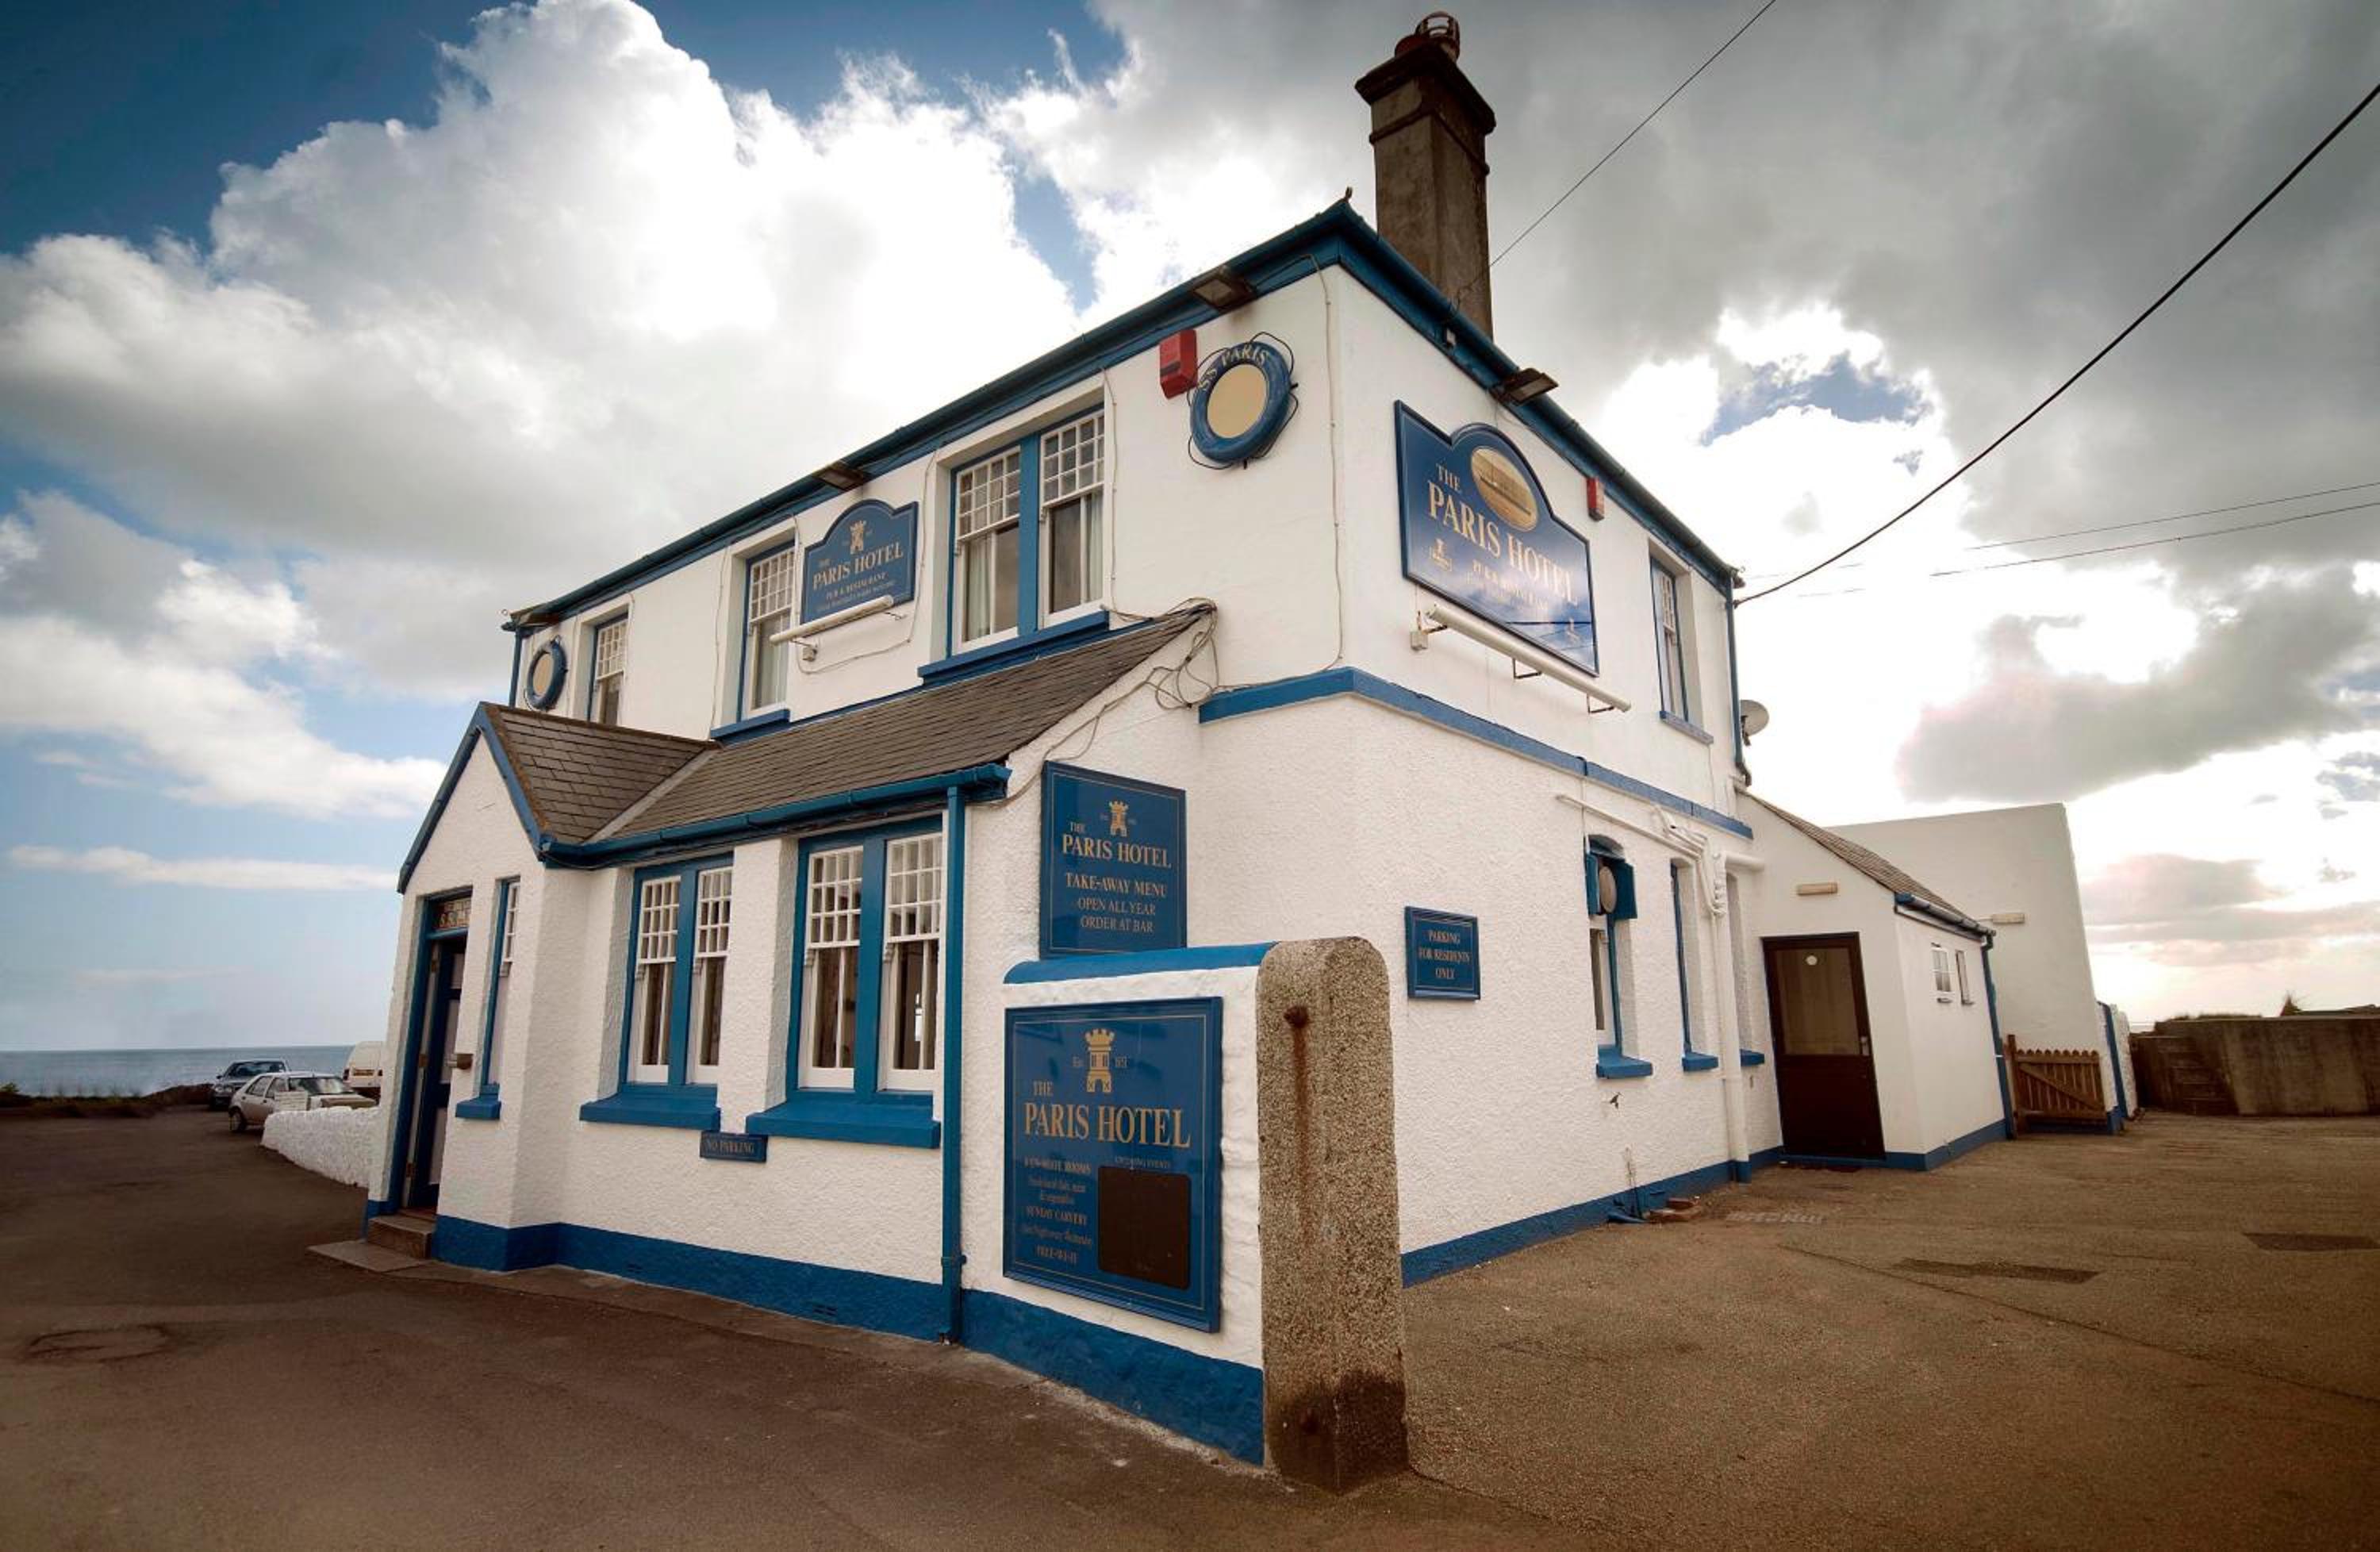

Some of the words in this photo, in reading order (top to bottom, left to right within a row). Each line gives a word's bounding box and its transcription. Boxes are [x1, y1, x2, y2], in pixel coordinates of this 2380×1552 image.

[1222, 344, 1269, 367] PARIS
[1436, 463, 1461, 493] THE
[1427, 480, 1501, 559] PARIS
[1507, 532, 1578, 606] HOTEL
[812, 561, 851, 590] PARIS
[854, 542, 904, 575] HOTEL
[1070, 821, 1086, 833] THE
[1062, 834, 1111, 861] PARIS
[1118, 842, 1172, 869] HOTEL
[1065, 872, 1130, 893] TAKE-AWAY
[1134, 879, 1169, 897] MENU
[1077, 897, 1106, 912] OPEN
[1109, 900, 1127, 913] ALL
[1128, 901, 1156, 916] YEAR
[1081, 915, 1116, 930] ORDER
[1117, 918, 1131, 931] AT
[1133, 920, 1154, 932] BAR
[1418, 947, 1433, 960] FOR
[1435, 967, 1455, 980] ONLY
[1033, 1081, 1054, 1097] THE
[1023, 1102, 1089, 1141] PARIS
[1098, 1106, 1191, 1148] HOTEL
[1027, 1205, 1054, 1220] SUNDAY
[1054, 1210, 1088, 1226] CARVERY
